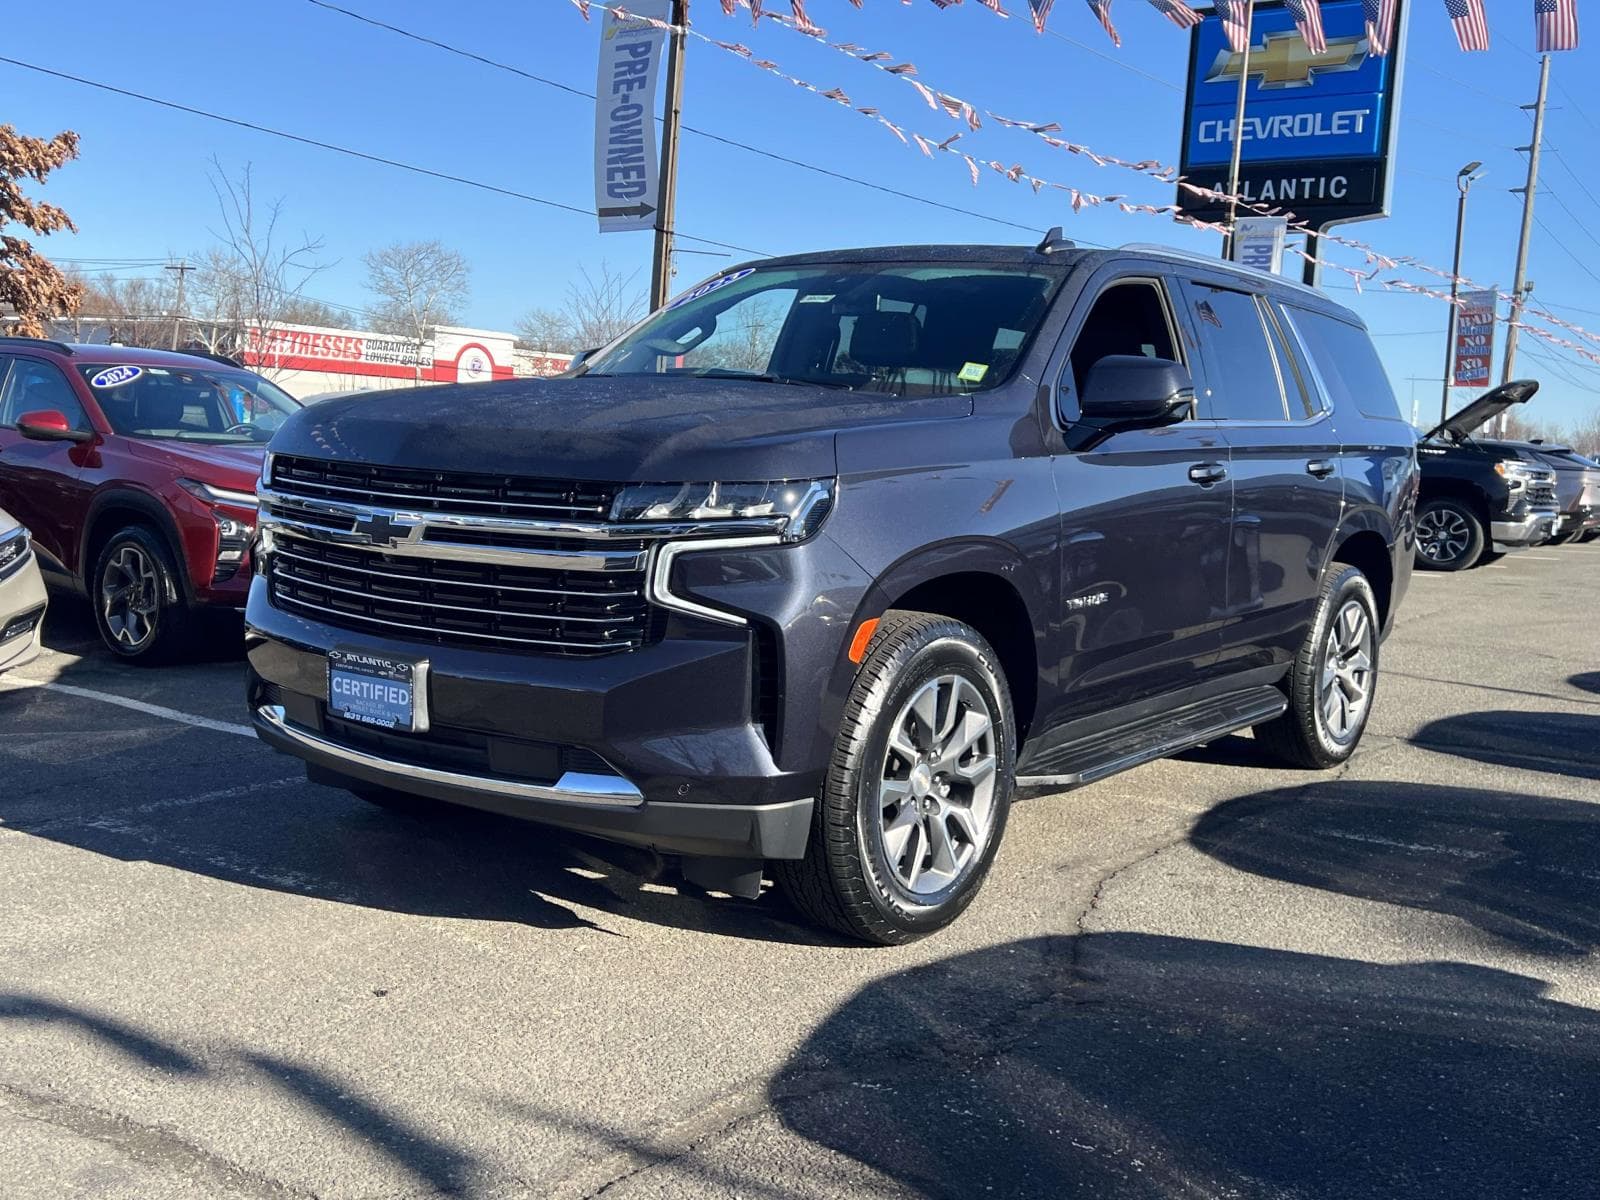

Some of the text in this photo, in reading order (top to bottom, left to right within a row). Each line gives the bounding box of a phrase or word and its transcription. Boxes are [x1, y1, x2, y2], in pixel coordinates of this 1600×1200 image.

[607, 40, 653, 199] PRE-OWNED
[1199, 109, 1370, 143] CHEVROLET
[1210, 175, 1348, 203] ALANTIC
[1459, 313, 1492, 327] BAD
[366, 339, 418, 353] GUARANTEE
[1464, 335, 1486, 347] NO
[365, 352, 400, 363] LOWEST
[402, 355, 431, 367] PRIES
[1461, 358, 1482, 370] NO
[99, 366, 133, 385] 2024
[345, 653, 392, 669] ATLANTIC
[332, 677, 409, 705] CERTIFIED
